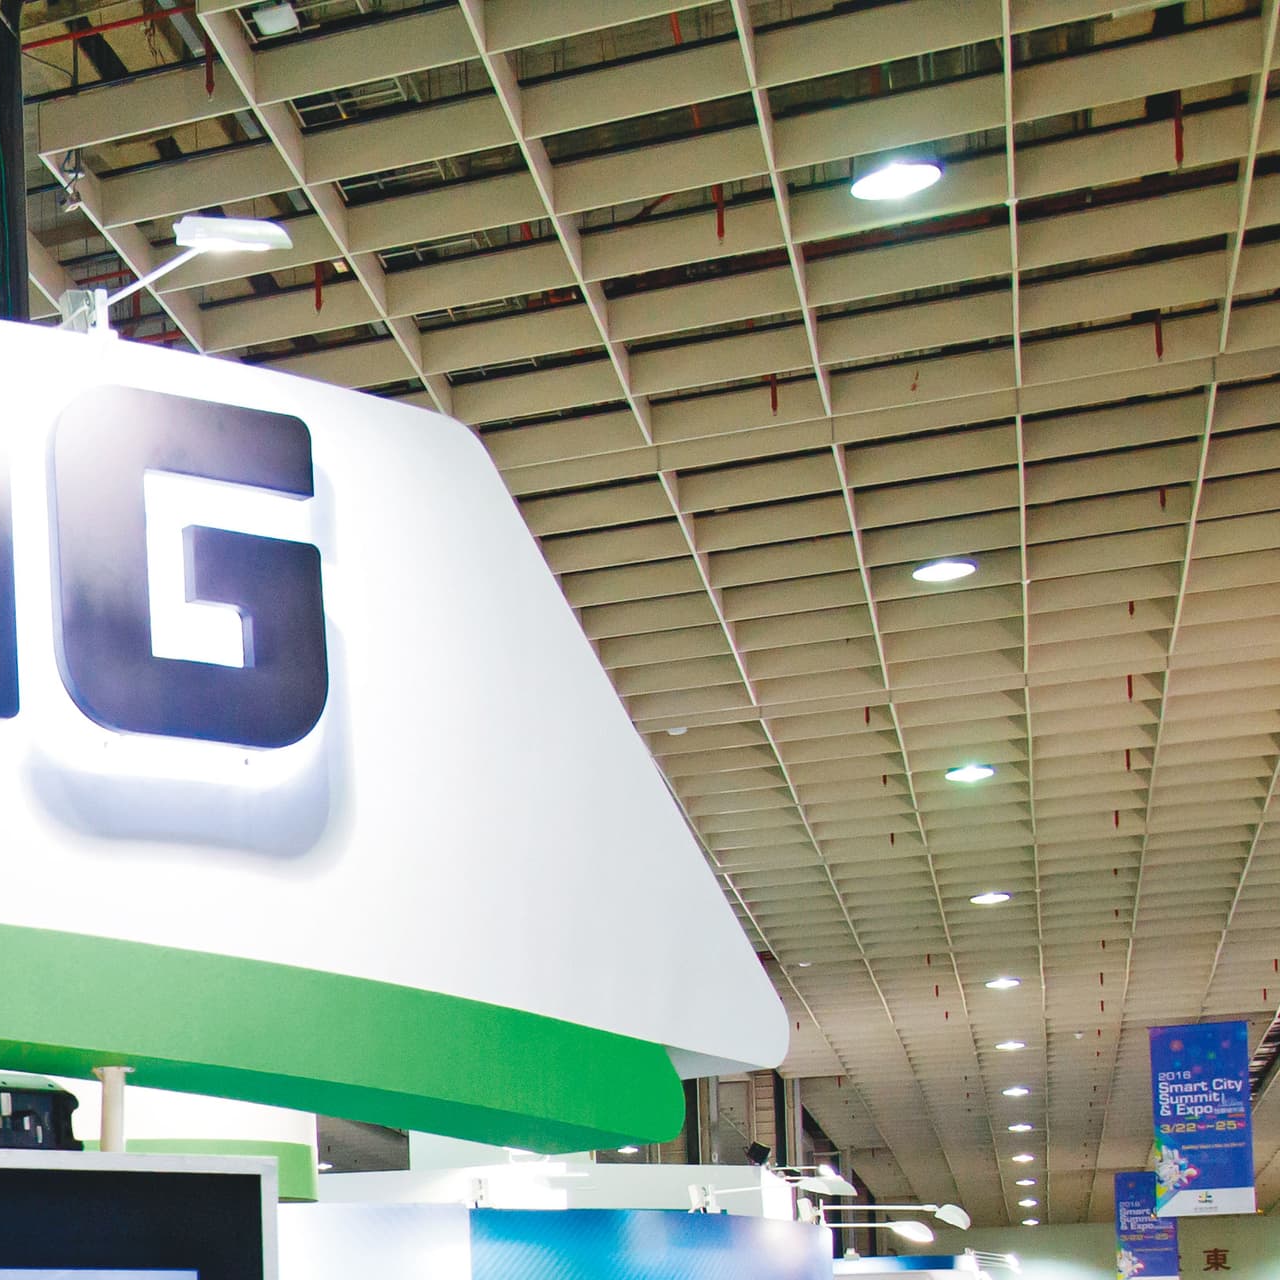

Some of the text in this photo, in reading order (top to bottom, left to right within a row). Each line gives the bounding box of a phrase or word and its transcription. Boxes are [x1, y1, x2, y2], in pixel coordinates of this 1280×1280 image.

[1158, 1071, 1192, 1081] 2016
[1158, 1078, 1243, 1093] Smart City
[1158, 1090, 1221, 1105] Summit
[1159, 1104, 1172, 1117] &
[1176, 1103, 1214, 1117] Expo
[1202, 1248, 1232, 1272] 東
